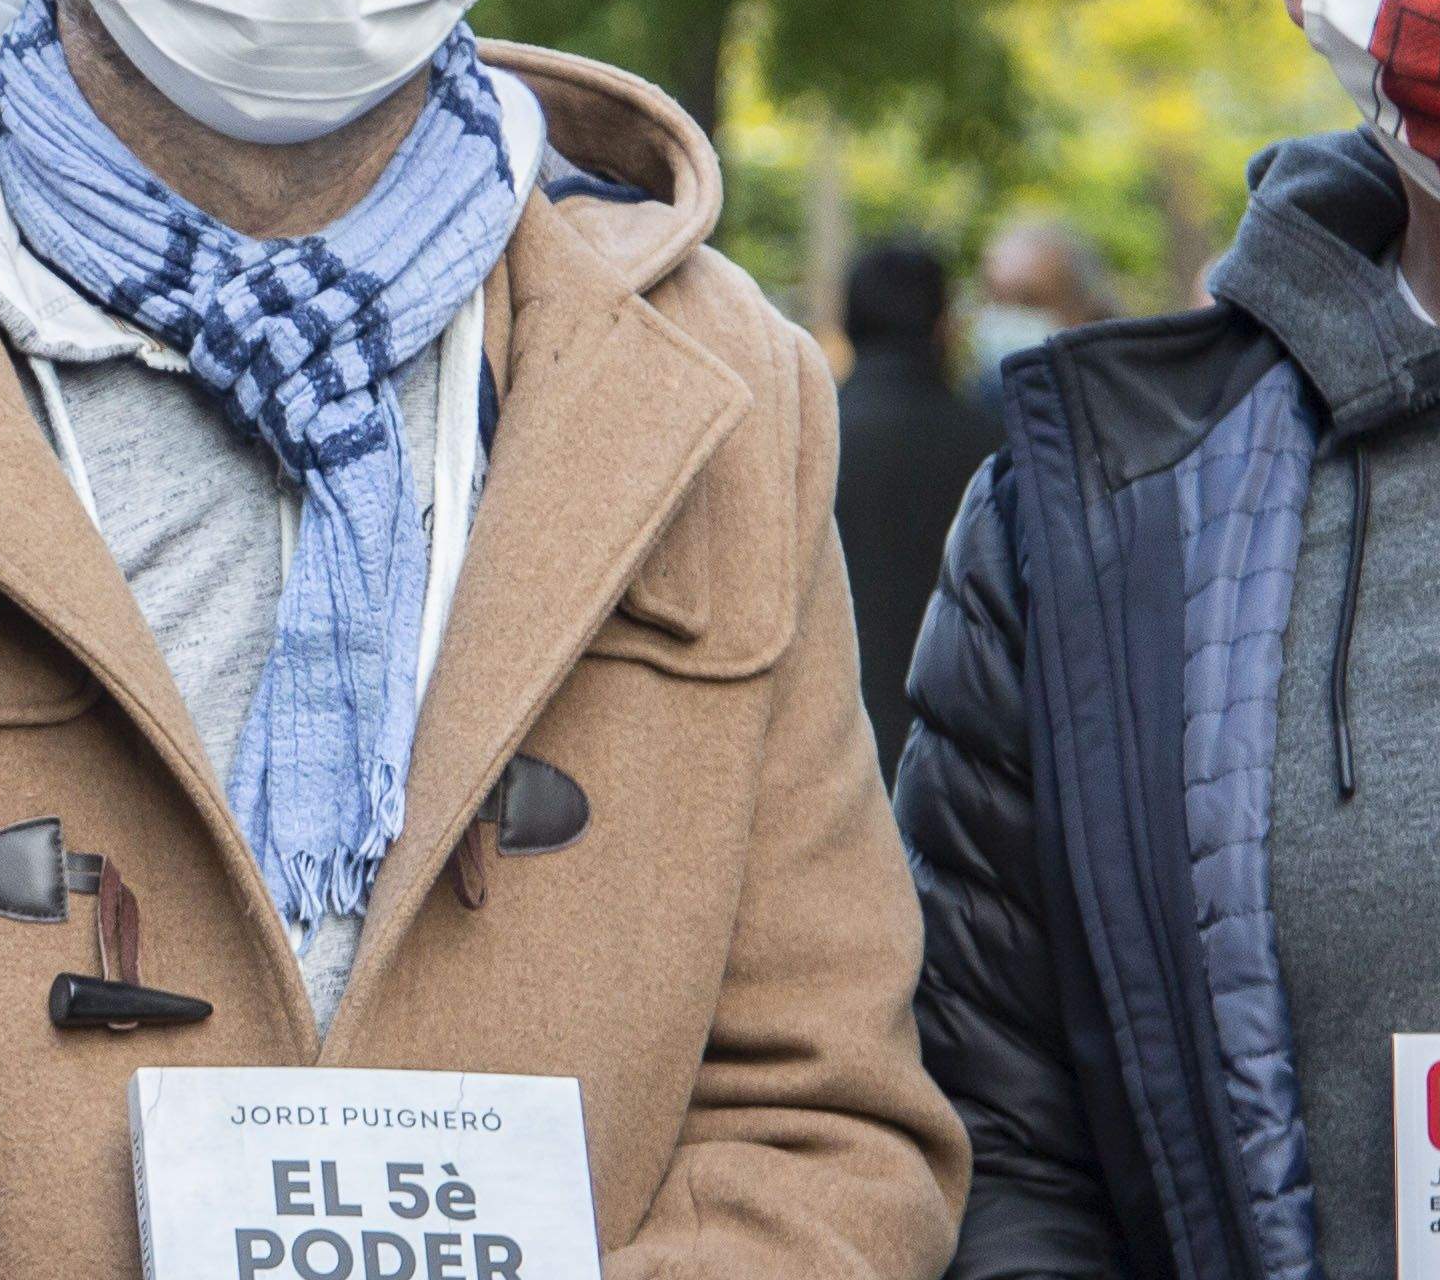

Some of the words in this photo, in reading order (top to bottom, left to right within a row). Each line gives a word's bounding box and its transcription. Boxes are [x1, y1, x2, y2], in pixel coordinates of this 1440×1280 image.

[230, 1105, 329, 1127] JORDI
[342, 1105, 503, 1132] PUIGNERÓ
[271, 1158, 363, 1218] EL
[385, 1161, 479, 1221] 5è
